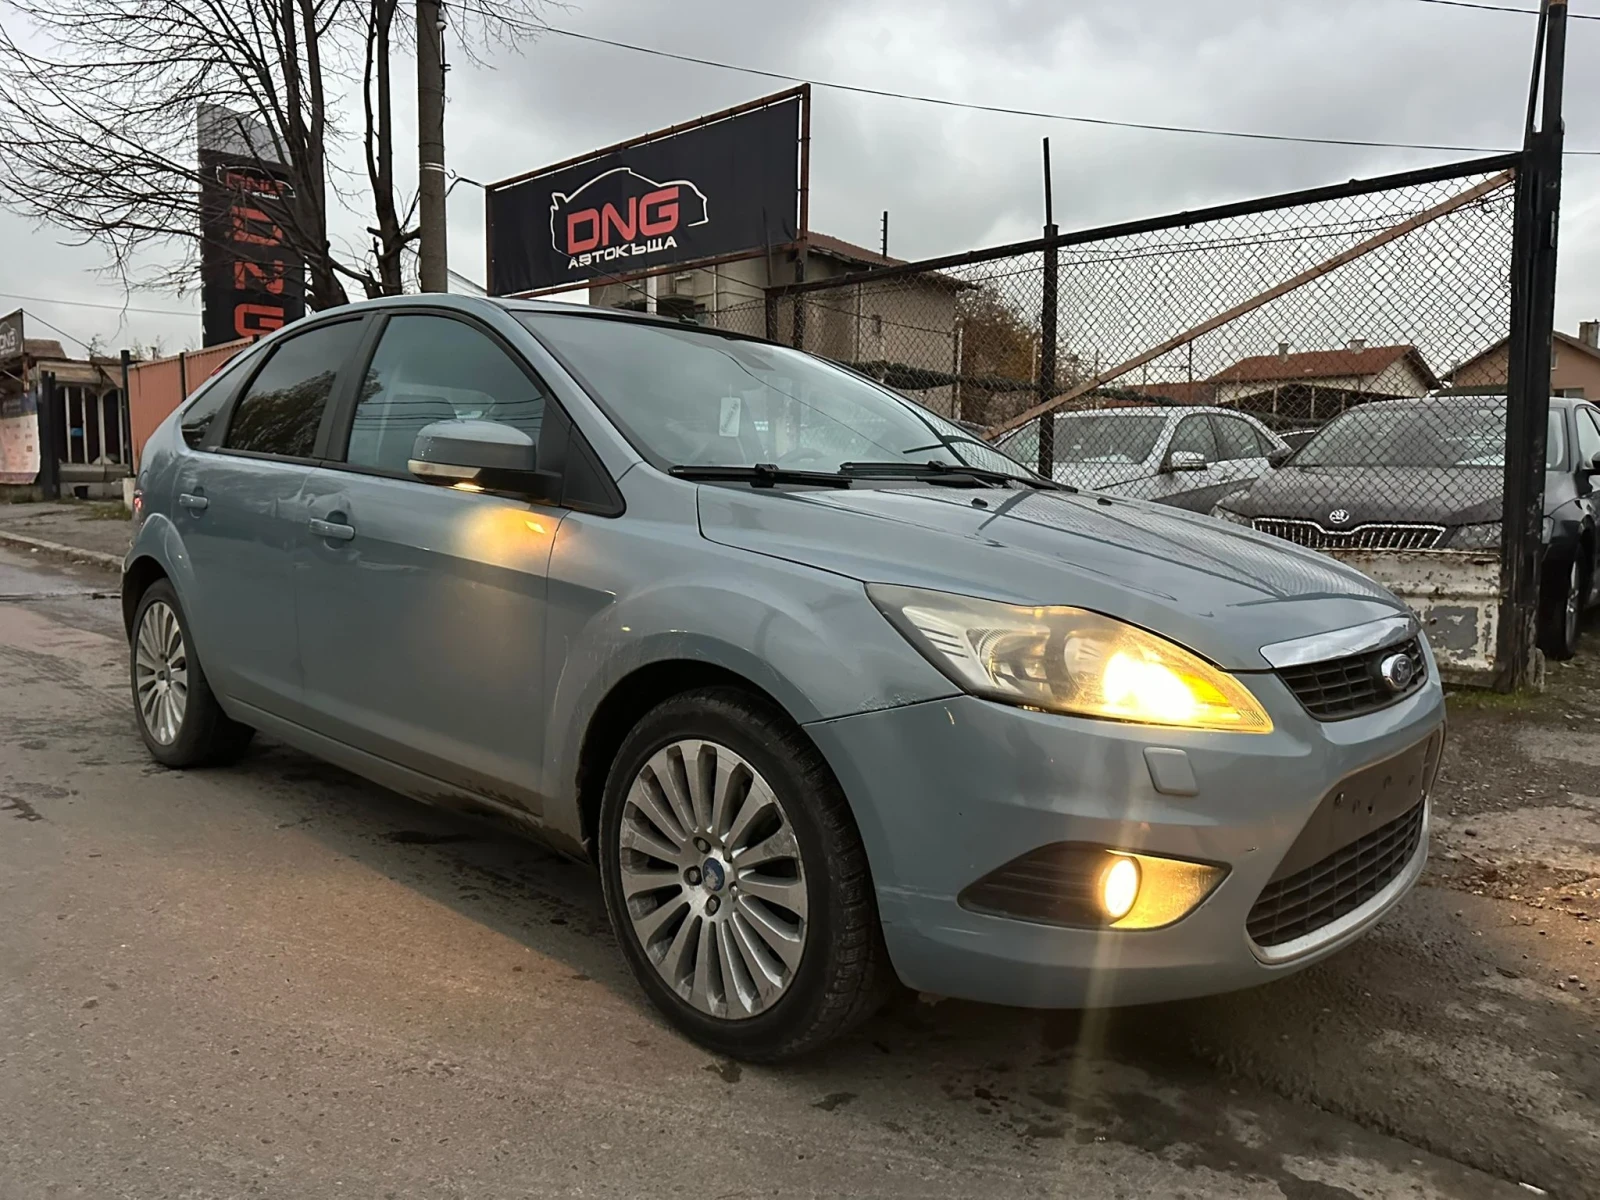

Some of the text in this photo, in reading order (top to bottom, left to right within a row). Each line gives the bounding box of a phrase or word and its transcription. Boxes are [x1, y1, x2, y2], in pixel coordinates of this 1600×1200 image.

[567, 186, 679, 255] DNG
[568, 235, 678, 270] АВТОКЪЩА
[231, 205, 285, 337] DNG
